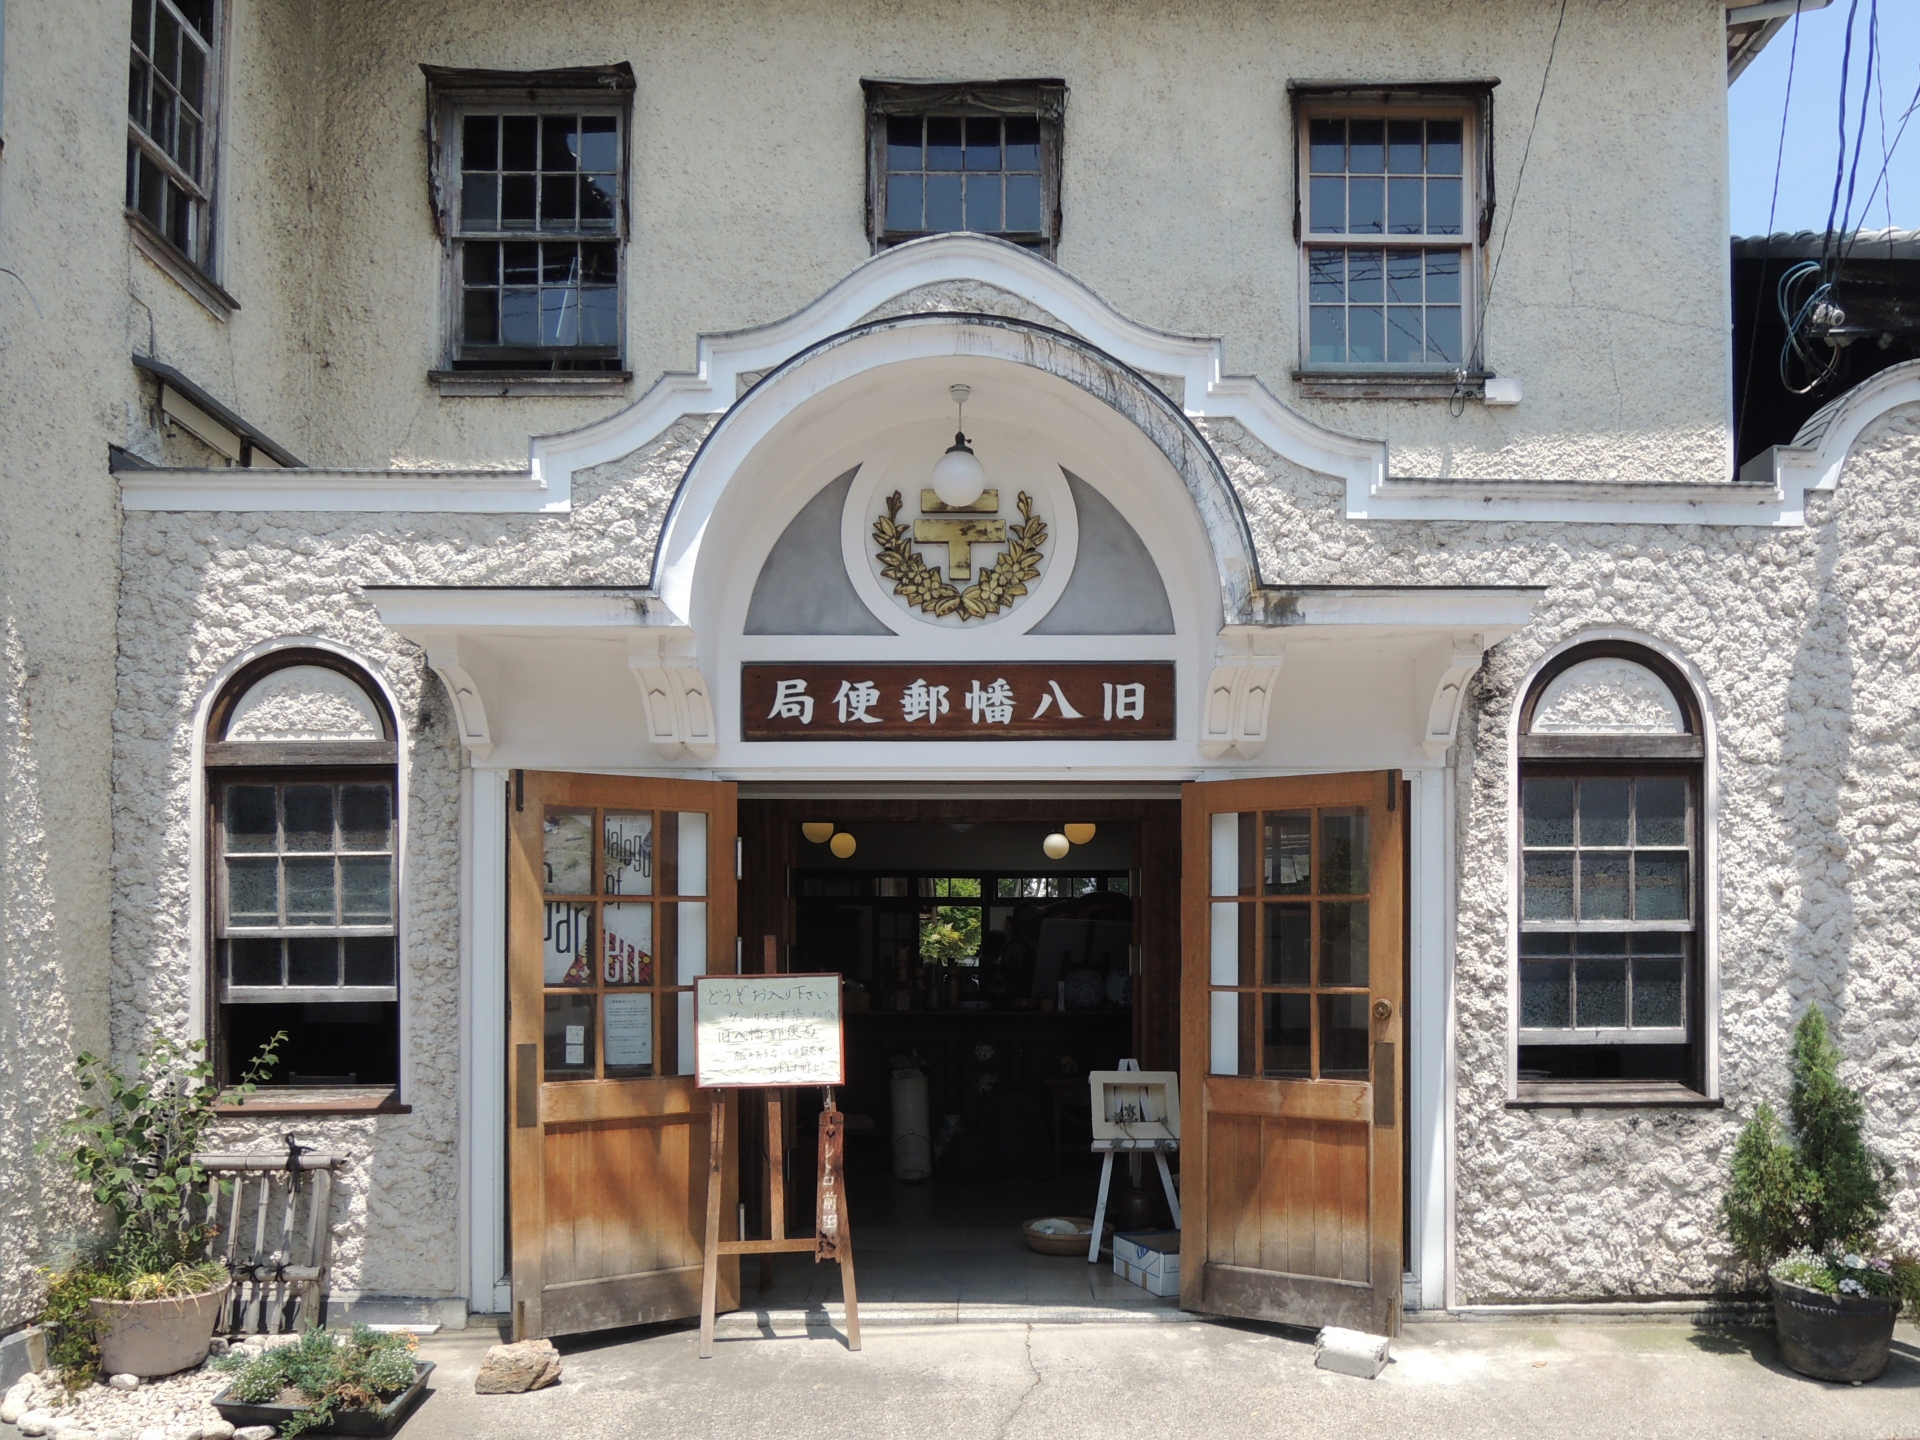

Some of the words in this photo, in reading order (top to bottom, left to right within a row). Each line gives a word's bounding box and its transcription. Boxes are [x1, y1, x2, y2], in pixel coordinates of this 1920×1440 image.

[767, 678, 1145, 725] 旧八幡郵便局
[605, 867, 622, 911] of
